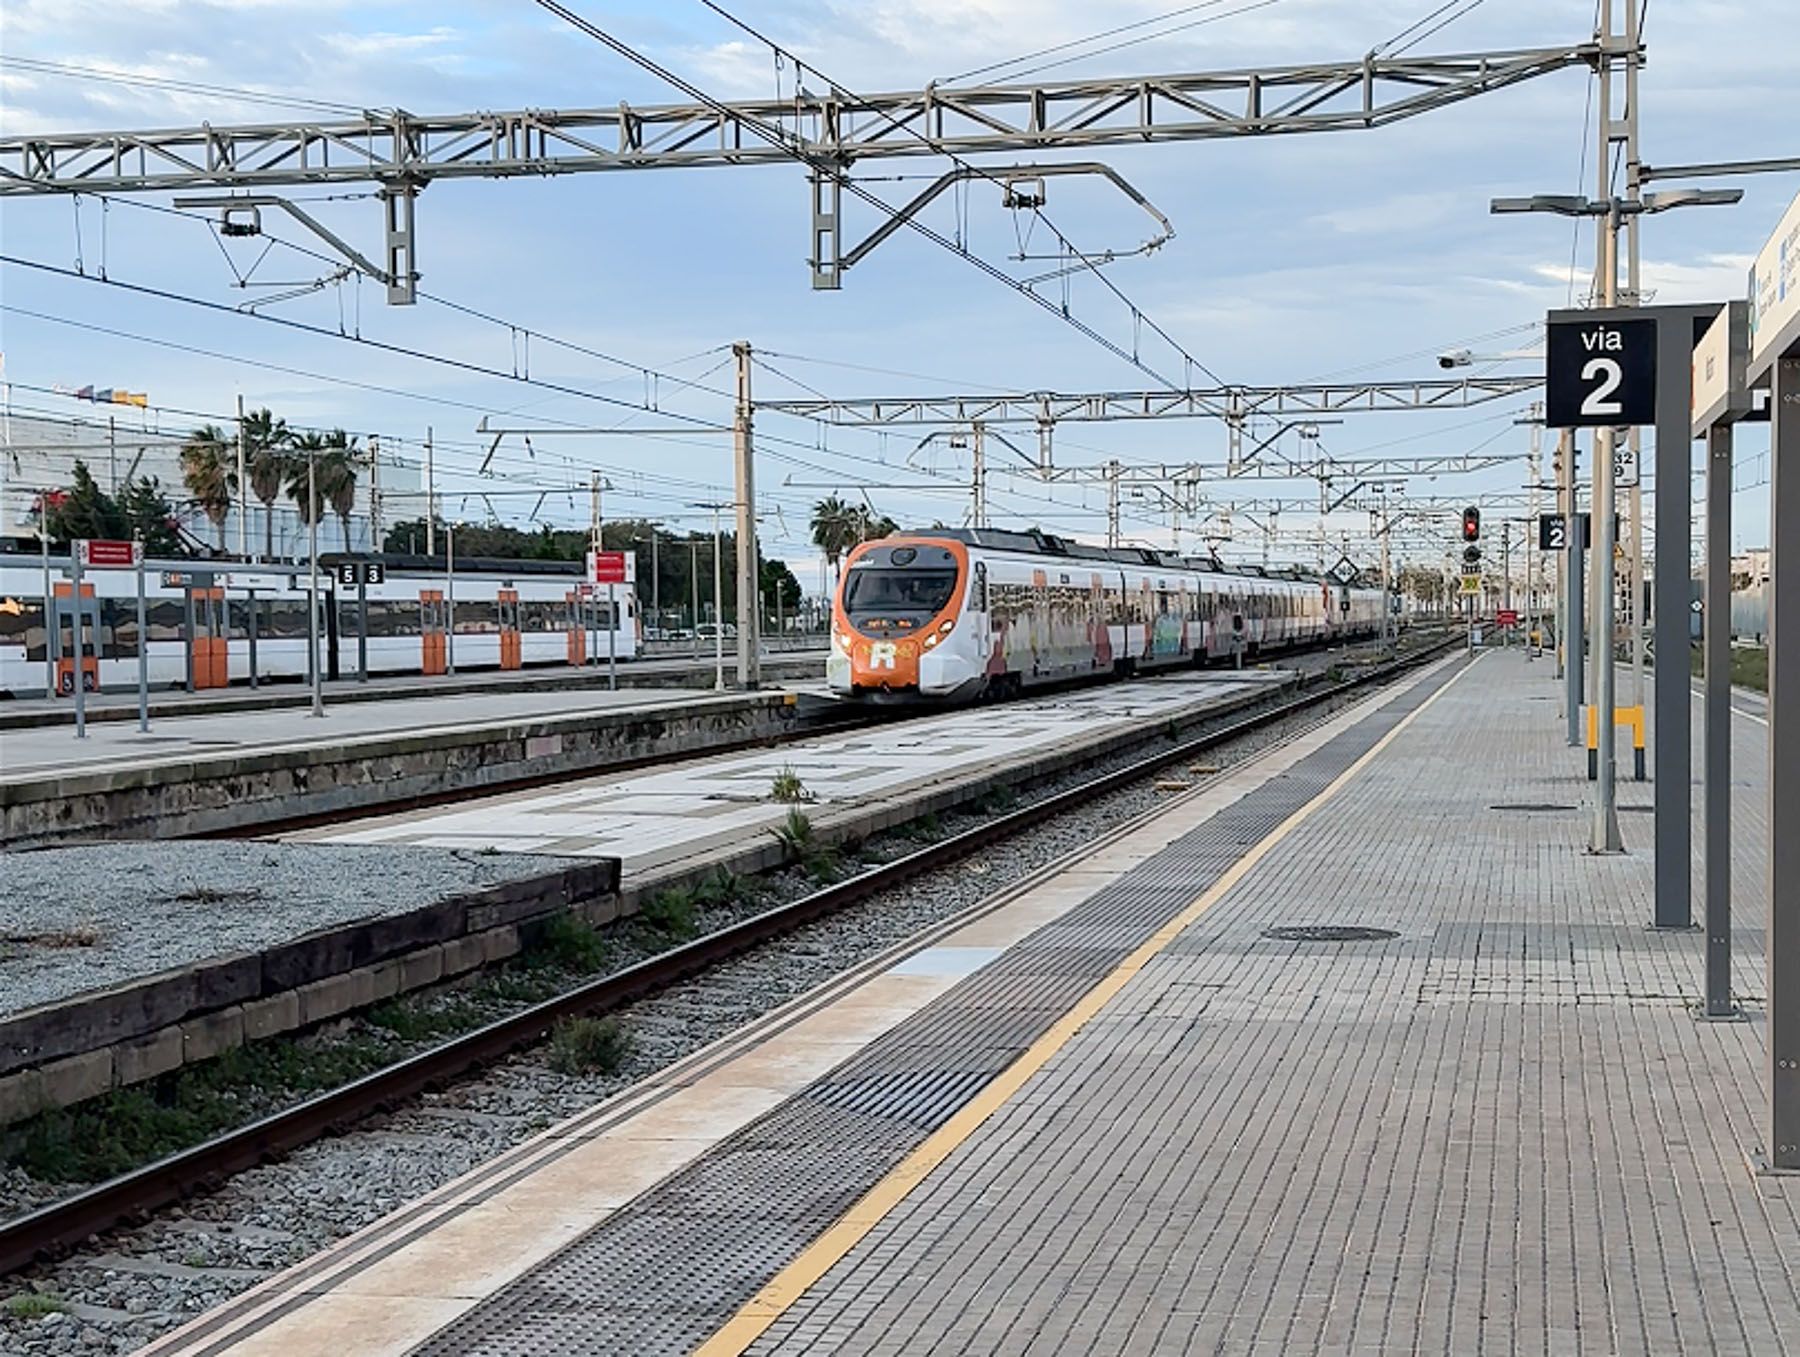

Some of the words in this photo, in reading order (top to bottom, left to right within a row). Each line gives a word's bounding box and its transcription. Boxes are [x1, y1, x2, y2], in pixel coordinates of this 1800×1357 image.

[1581, 326, 1623, 351] via
[1580, 357, 1623, 416] 2
[1549, 528, 1564, 547] 2
[344, 570, 353, 583] 5
[369, 570, 379, 583] 3
